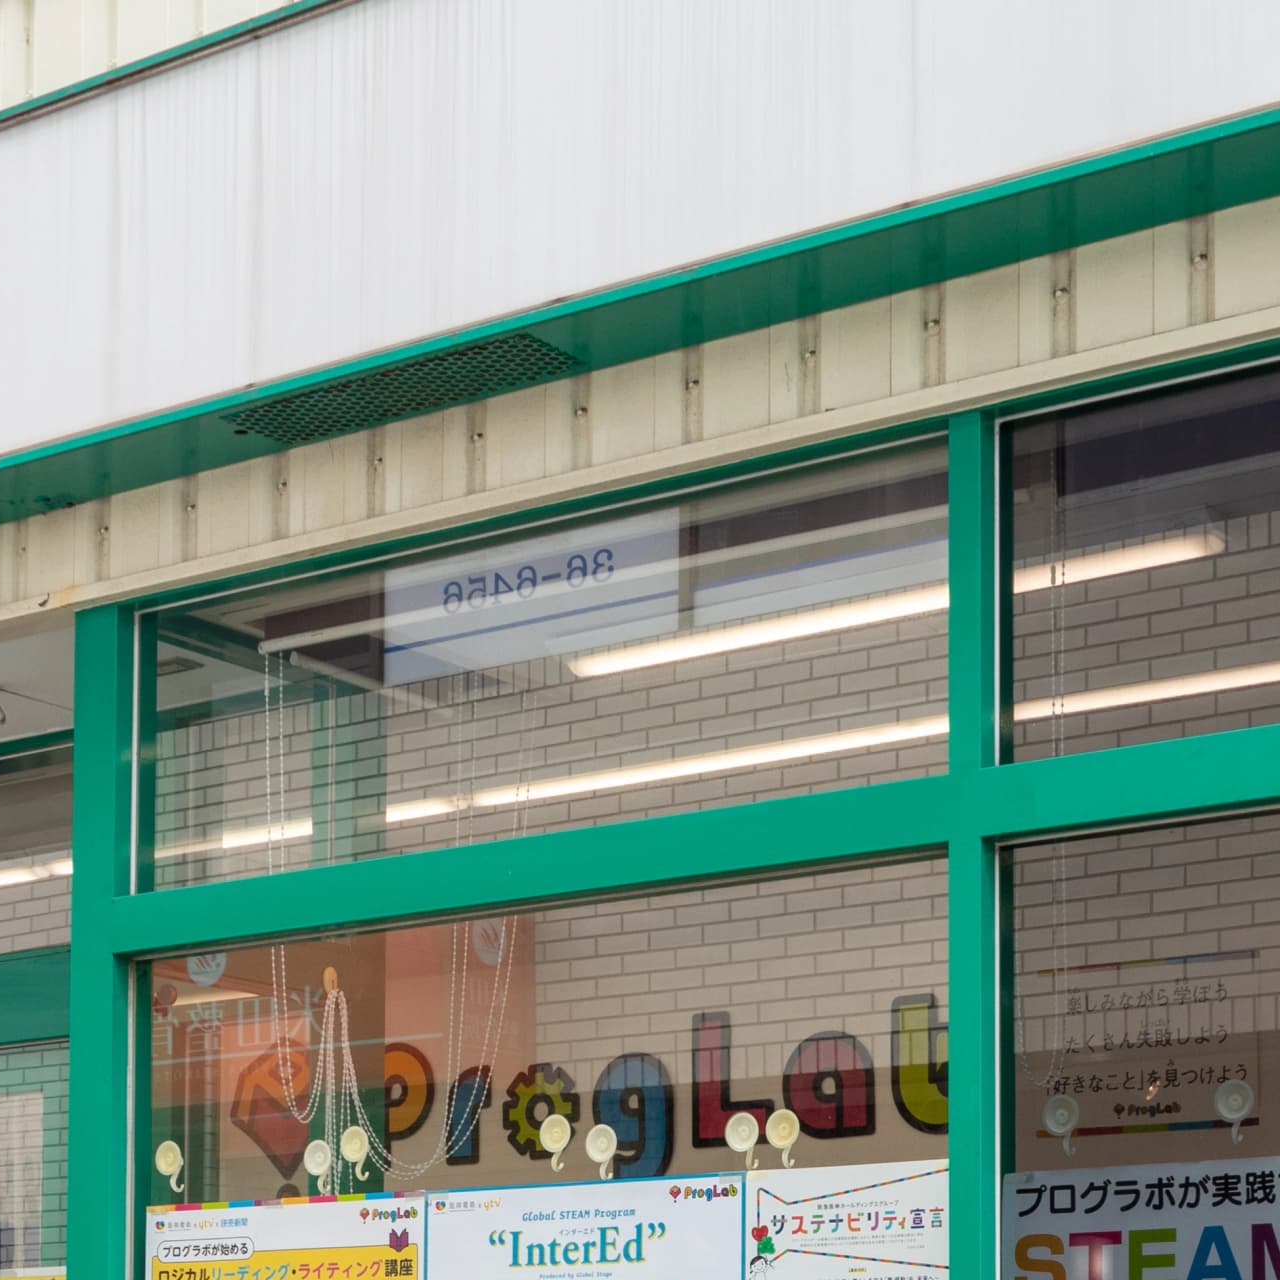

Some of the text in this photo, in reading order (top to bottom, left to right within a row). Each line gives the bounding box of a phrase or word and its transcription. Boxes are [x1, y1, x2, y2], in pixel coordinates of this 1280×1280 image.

[684, 1184, 738, 1201] ProgLab
[371, 1206, 418, 1223] ProgLab
[522, 1207, 636, 1222] Global STEAM Program
[771, 1206, 944, 1236] サステナビリティ宣言
[162, 1243, 249, 1258] プログラボが始める
